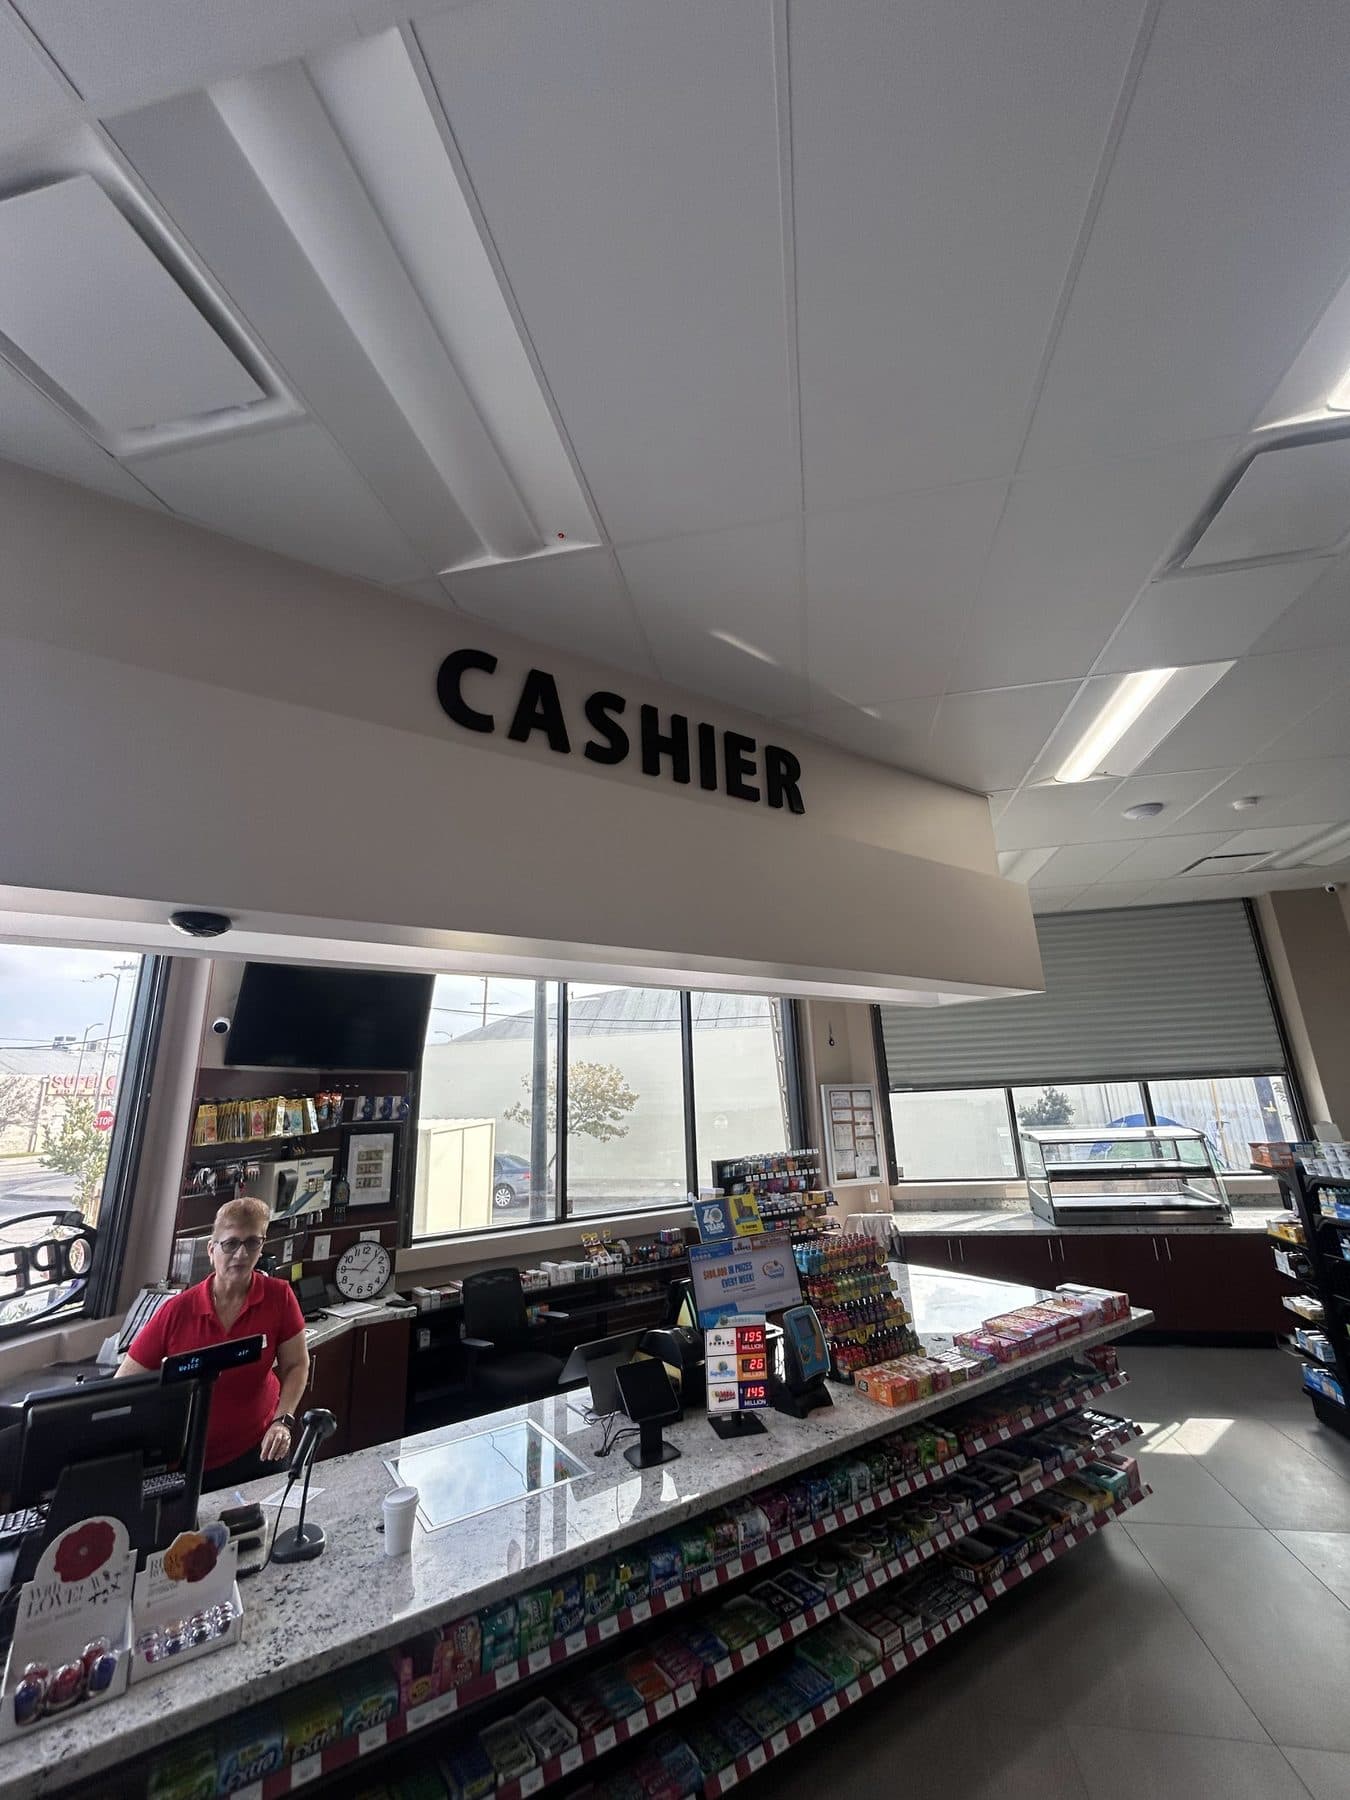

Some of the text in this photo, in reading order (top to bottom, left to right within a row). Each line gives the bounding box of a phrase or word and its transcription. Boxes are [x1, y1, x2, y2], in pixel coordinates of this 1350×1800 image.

[437, 649, 805, 815] CASHIER
[744, 1331, 762, 1342] 195
[749, 1359, 763, 1370] 26
[746, 1386, 765, 1397] 145
